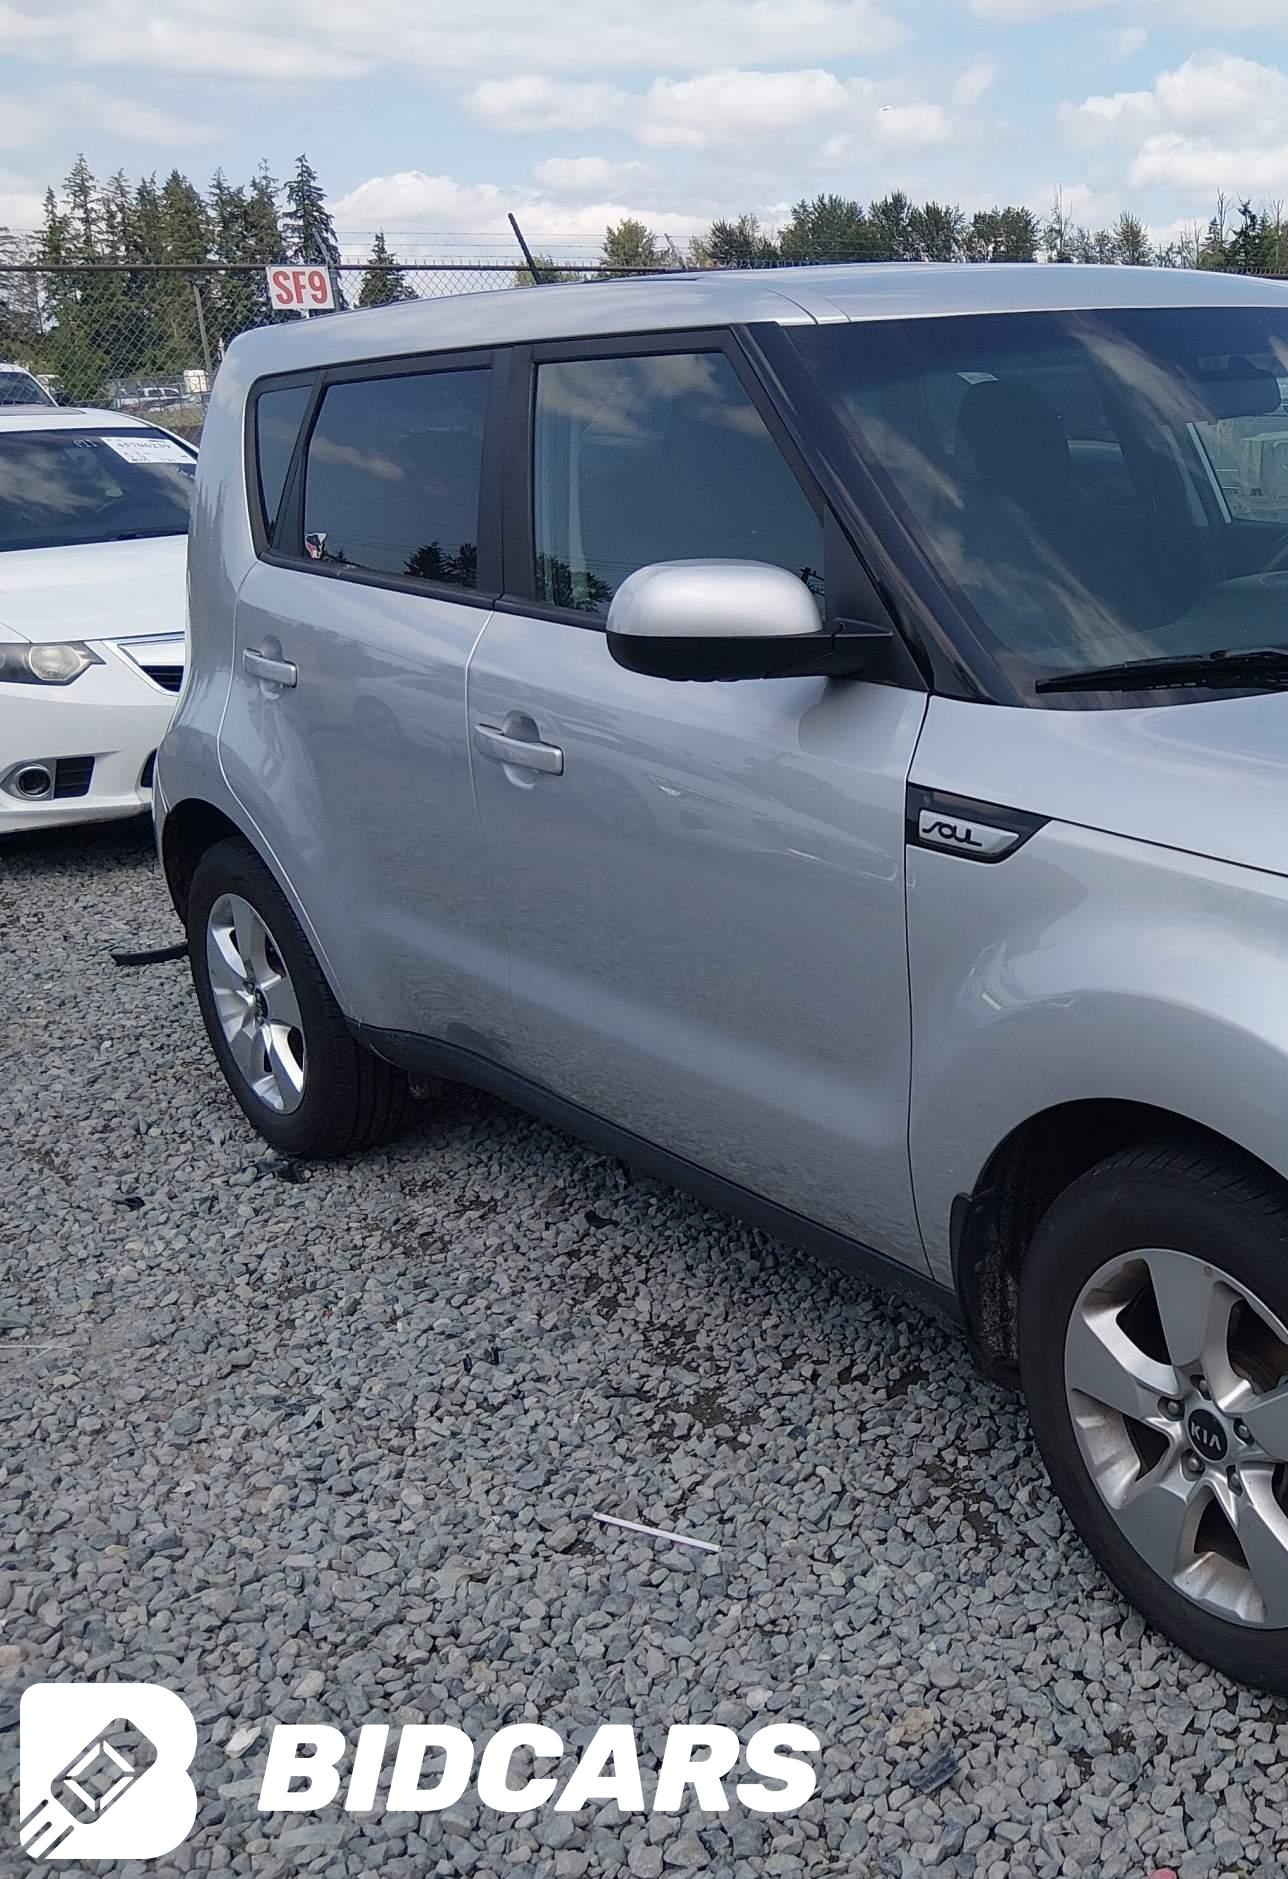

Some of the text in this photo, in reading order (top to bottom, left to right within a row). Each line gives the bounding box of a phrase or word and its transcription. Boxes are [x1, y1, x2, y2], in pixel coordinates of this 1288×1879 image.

[272, 270, 328, 305] SF9
[922, 821, 983, 847] SOUL
[1191, 1421, 1222, 1451] KIA
